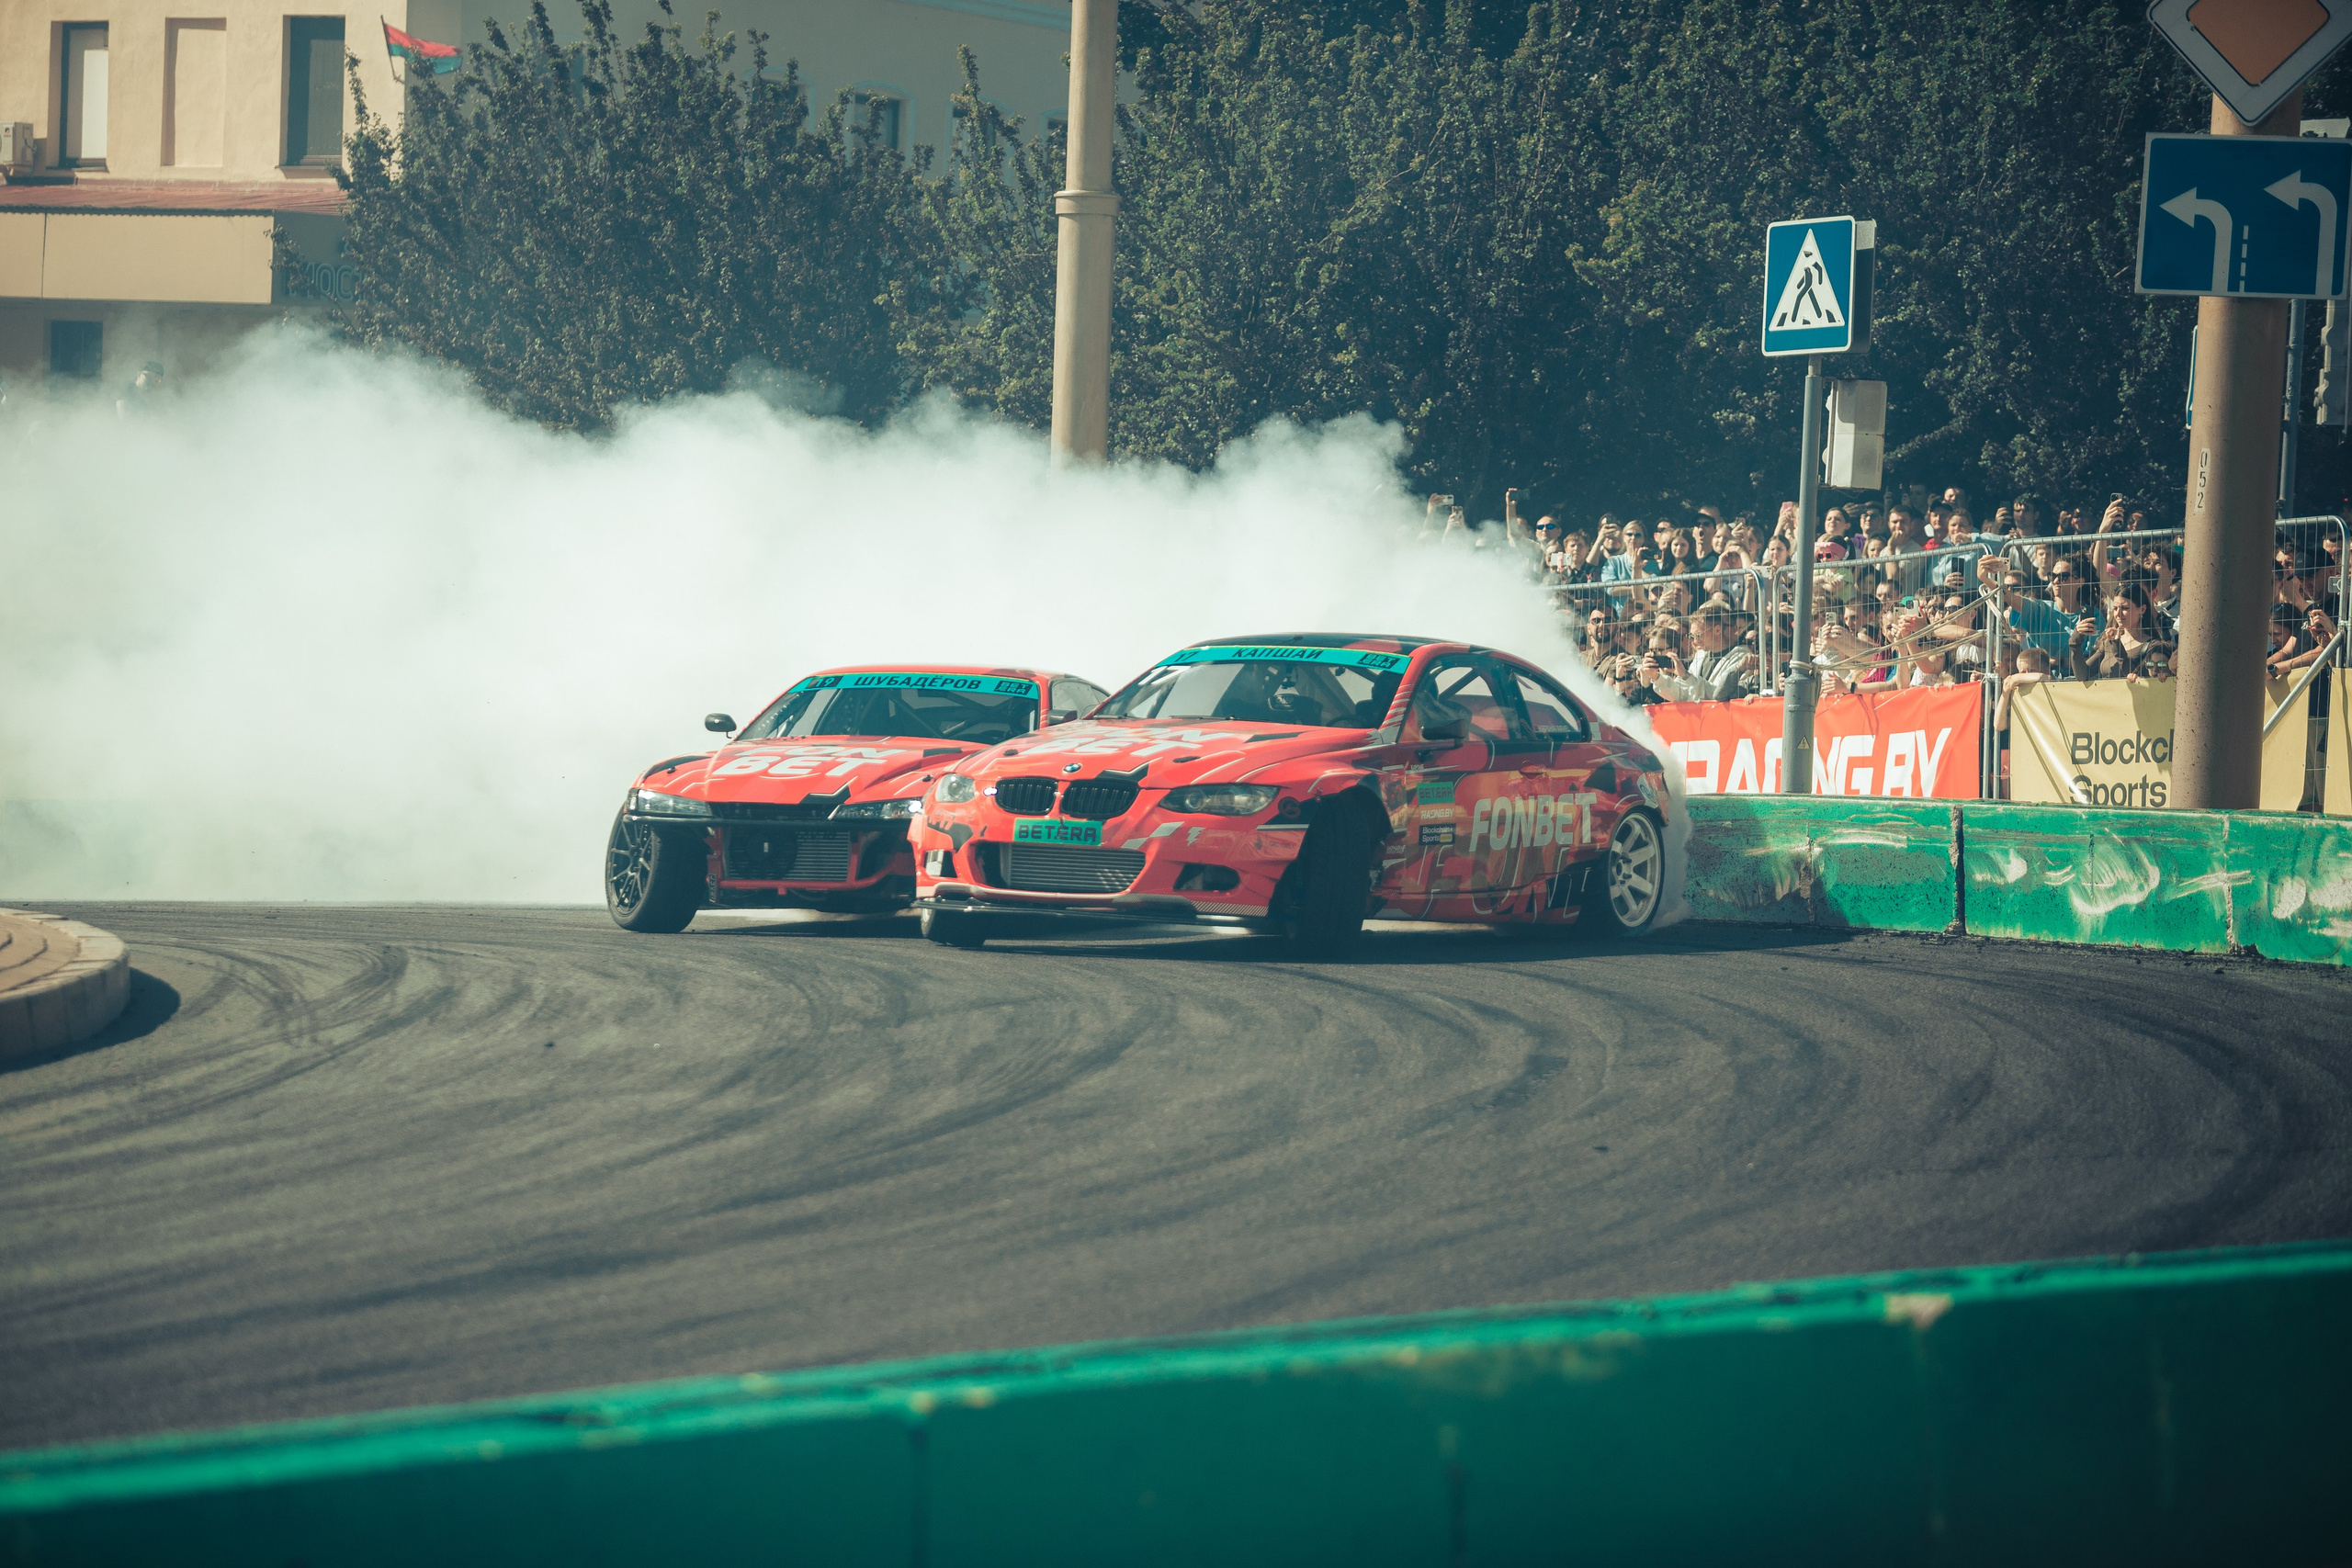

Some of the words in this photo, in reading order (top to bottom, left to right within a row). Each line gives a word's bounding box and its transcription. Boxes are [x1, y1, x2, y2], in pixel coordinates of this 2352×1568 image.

[2197, 451, 2208, 509] 052
[1174, 650, 1201, 663] 17
[814, 677, 835, 687] 19
[854, 675, 981, 690] ШУБАДЁРОВ
[735, 746, 908, 759] FON
[1019, 738, 1203, 757] BET
[712, 756, 888, 777] BET
[2069, 773, 2166, 807] Sports
[1469, 792, 1598, 852] FONBET
[1422, 834, 1440, 843] Sports
